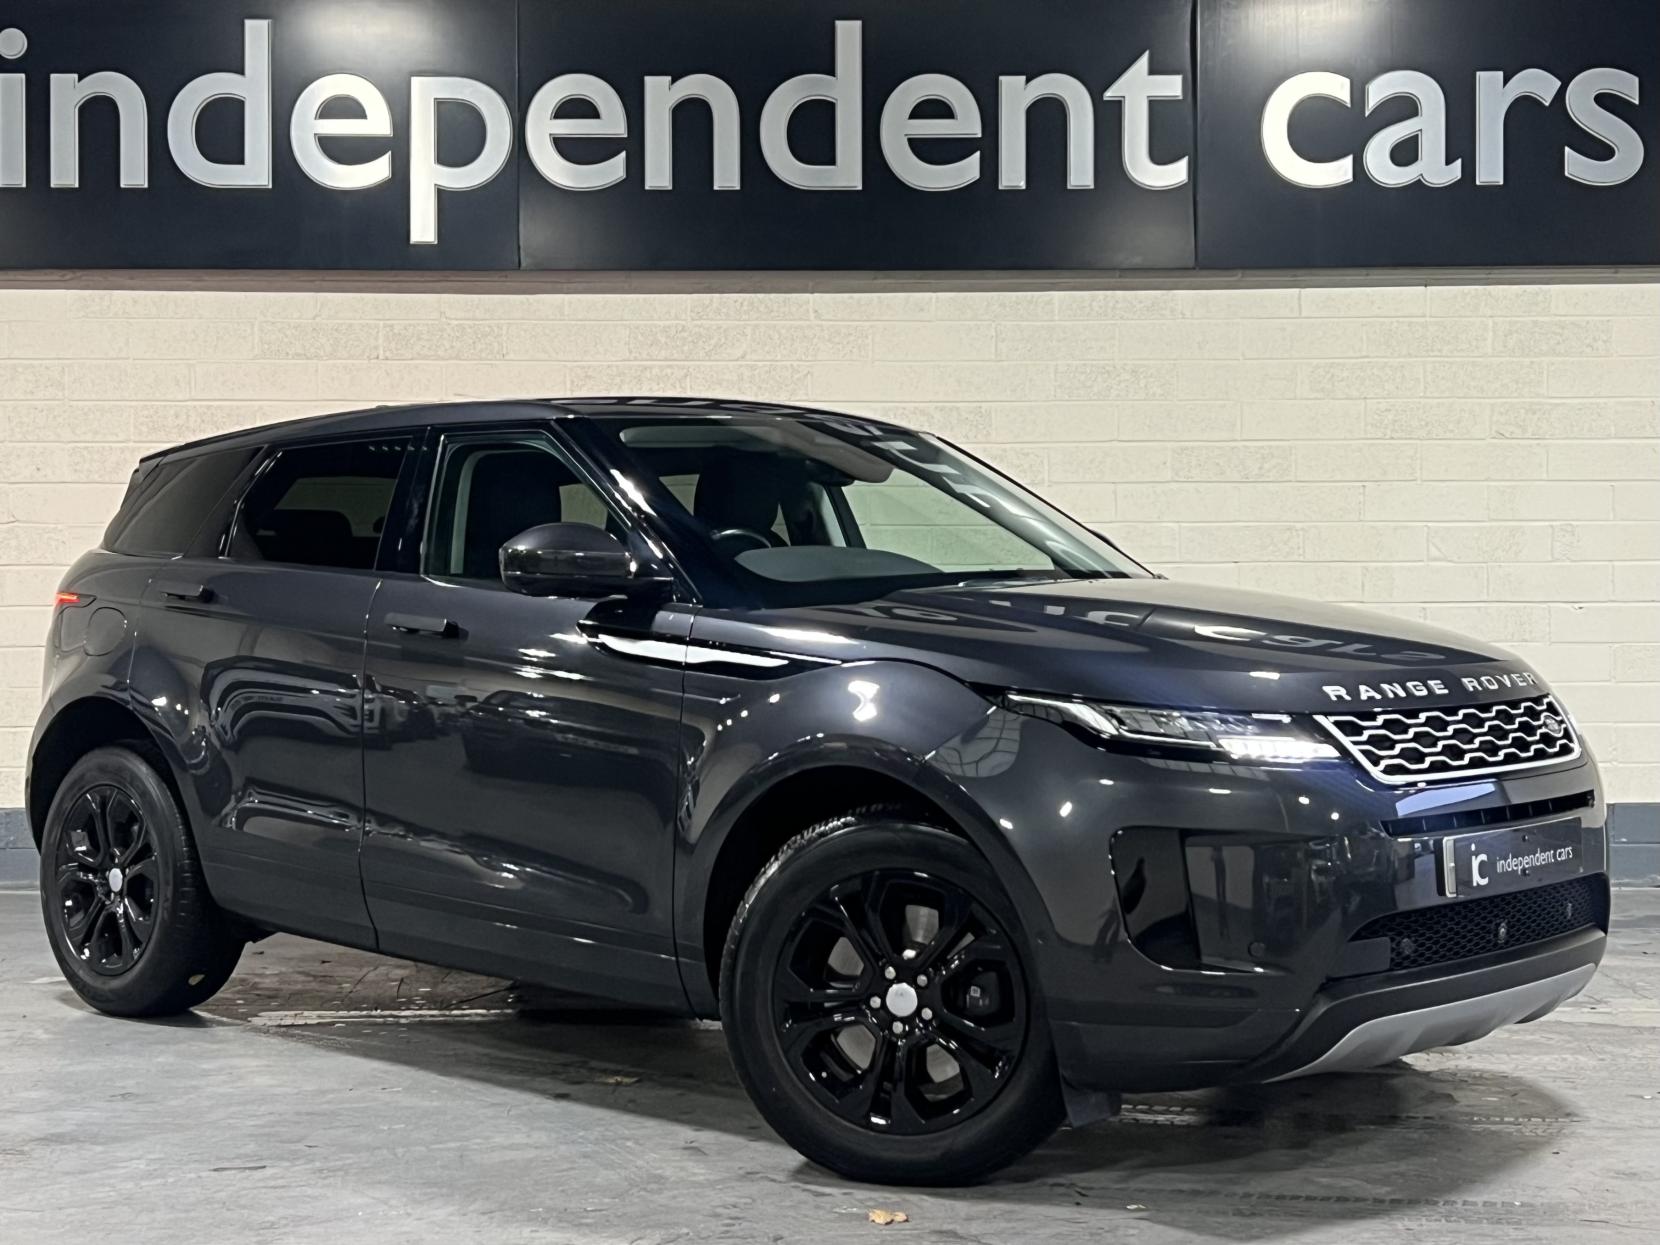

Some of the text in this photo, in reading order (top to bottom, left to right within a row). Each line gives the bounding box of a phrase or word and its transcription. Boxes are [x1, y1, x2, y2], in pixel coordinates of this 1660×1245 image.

[0, 18, 1644, 245] independent cars
[1322, 671, 1539, 701] RANGE ROVER
[1496, 846, 1573, 876] independent cars
